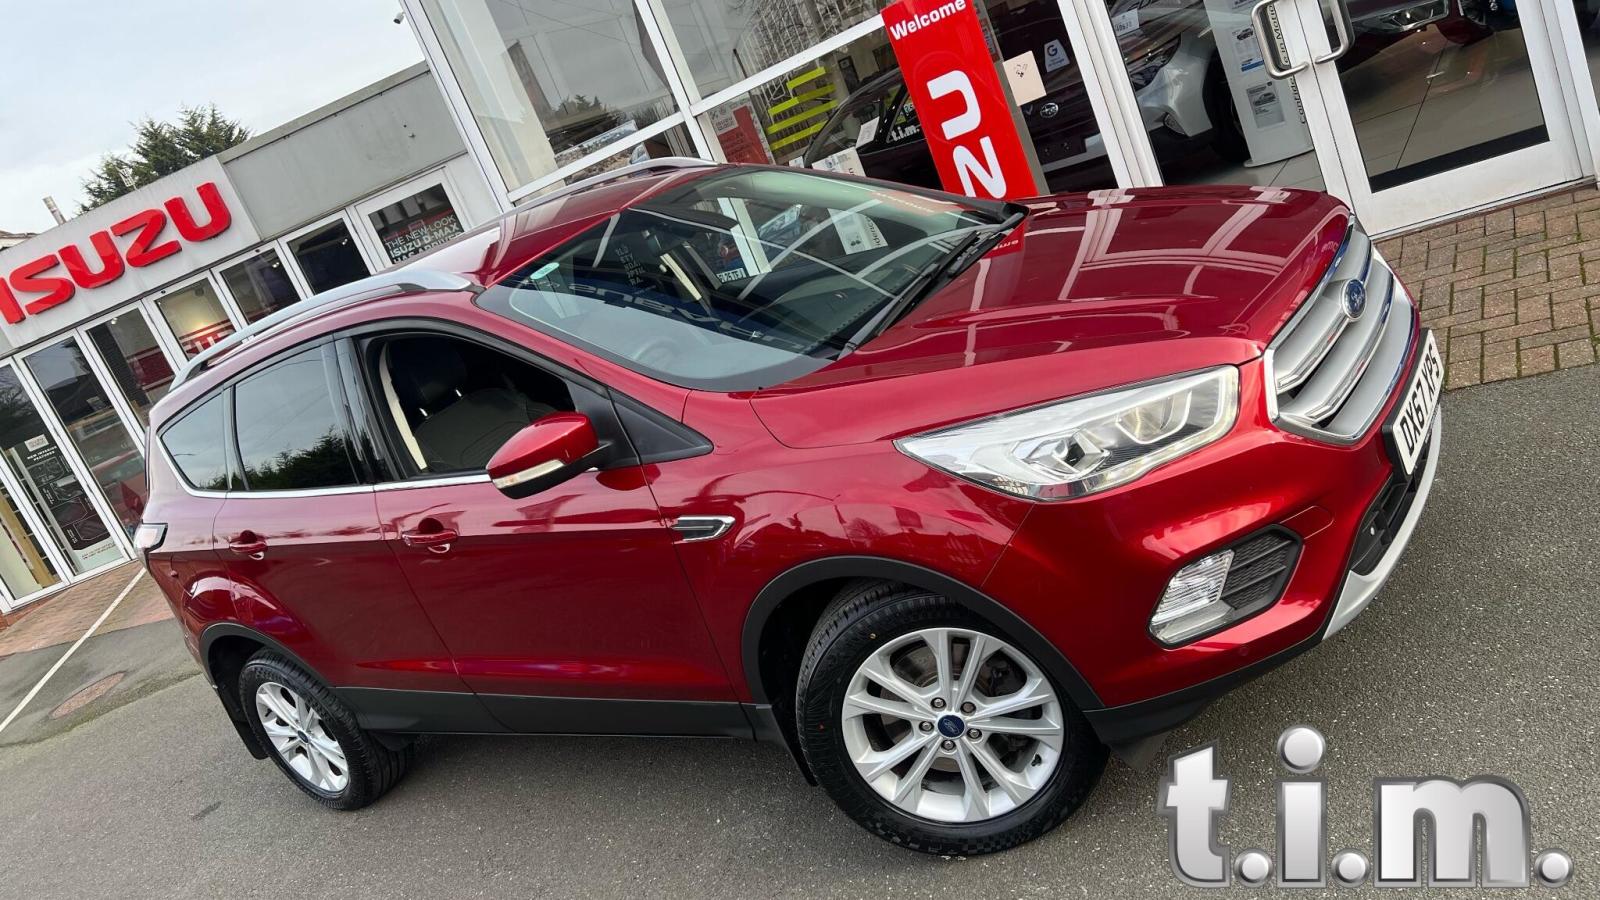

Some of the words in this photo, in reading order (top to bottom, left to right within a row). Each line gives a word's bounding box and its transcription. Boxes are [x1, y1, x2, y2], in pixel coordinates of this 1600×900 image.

[889, 0, 967, 41] Welcome
[0, 182, 232, 326] ISUZU
[385, 236, 405, 250] THE
[389, 239, 421, 258] ISUZU
[422, 222, 460, 245] D-MAX
[1399, 376, 1430, 458] DX67
[1421, 343, 1441, 402] XPS
